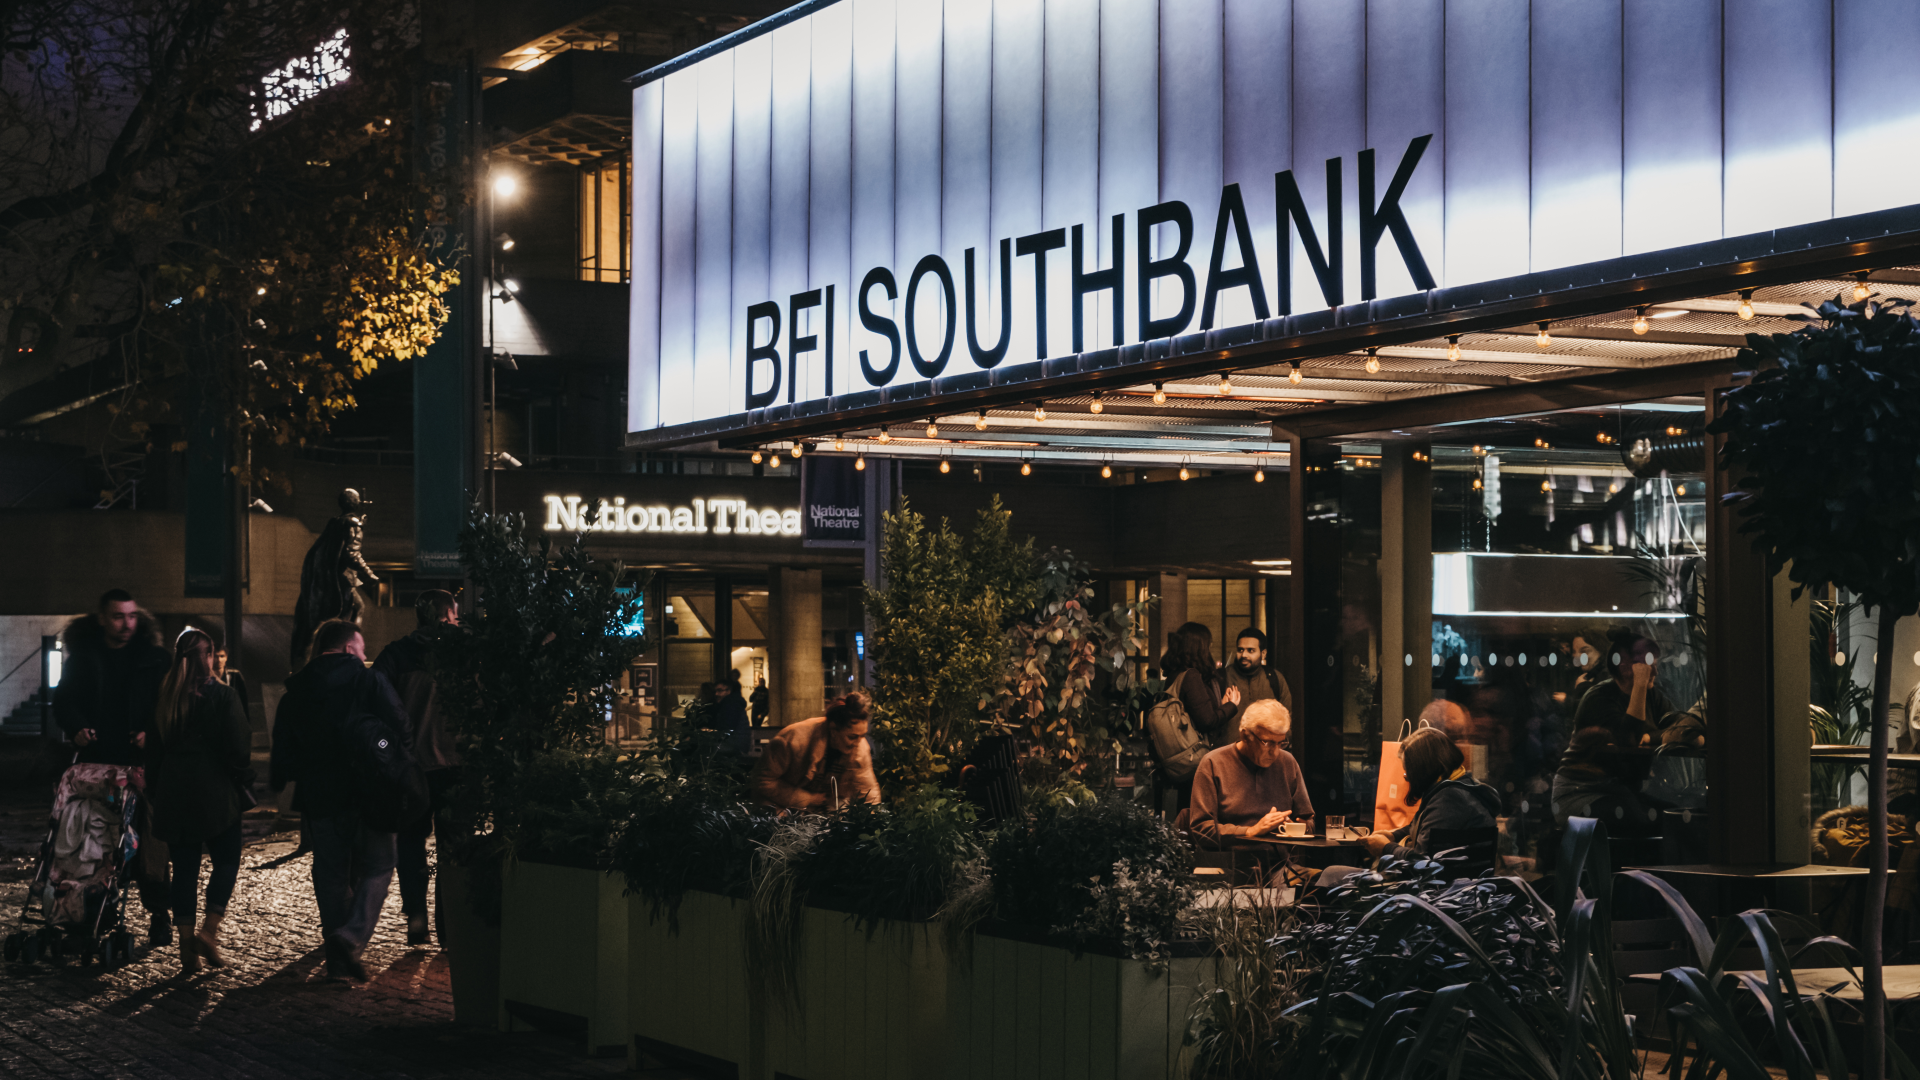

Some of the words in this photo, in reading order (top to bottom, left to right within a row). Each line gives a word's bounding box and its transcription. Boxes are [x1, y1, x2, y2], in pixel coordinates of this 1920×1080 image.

[745, 284, 835, 410] BFI
[858, 134, 1437, 387] SOUTHBANK
[544, 496, 706, 532] National
[709, 499, 801, 534] Thea
[811, 516, 860, 528] Theatre
